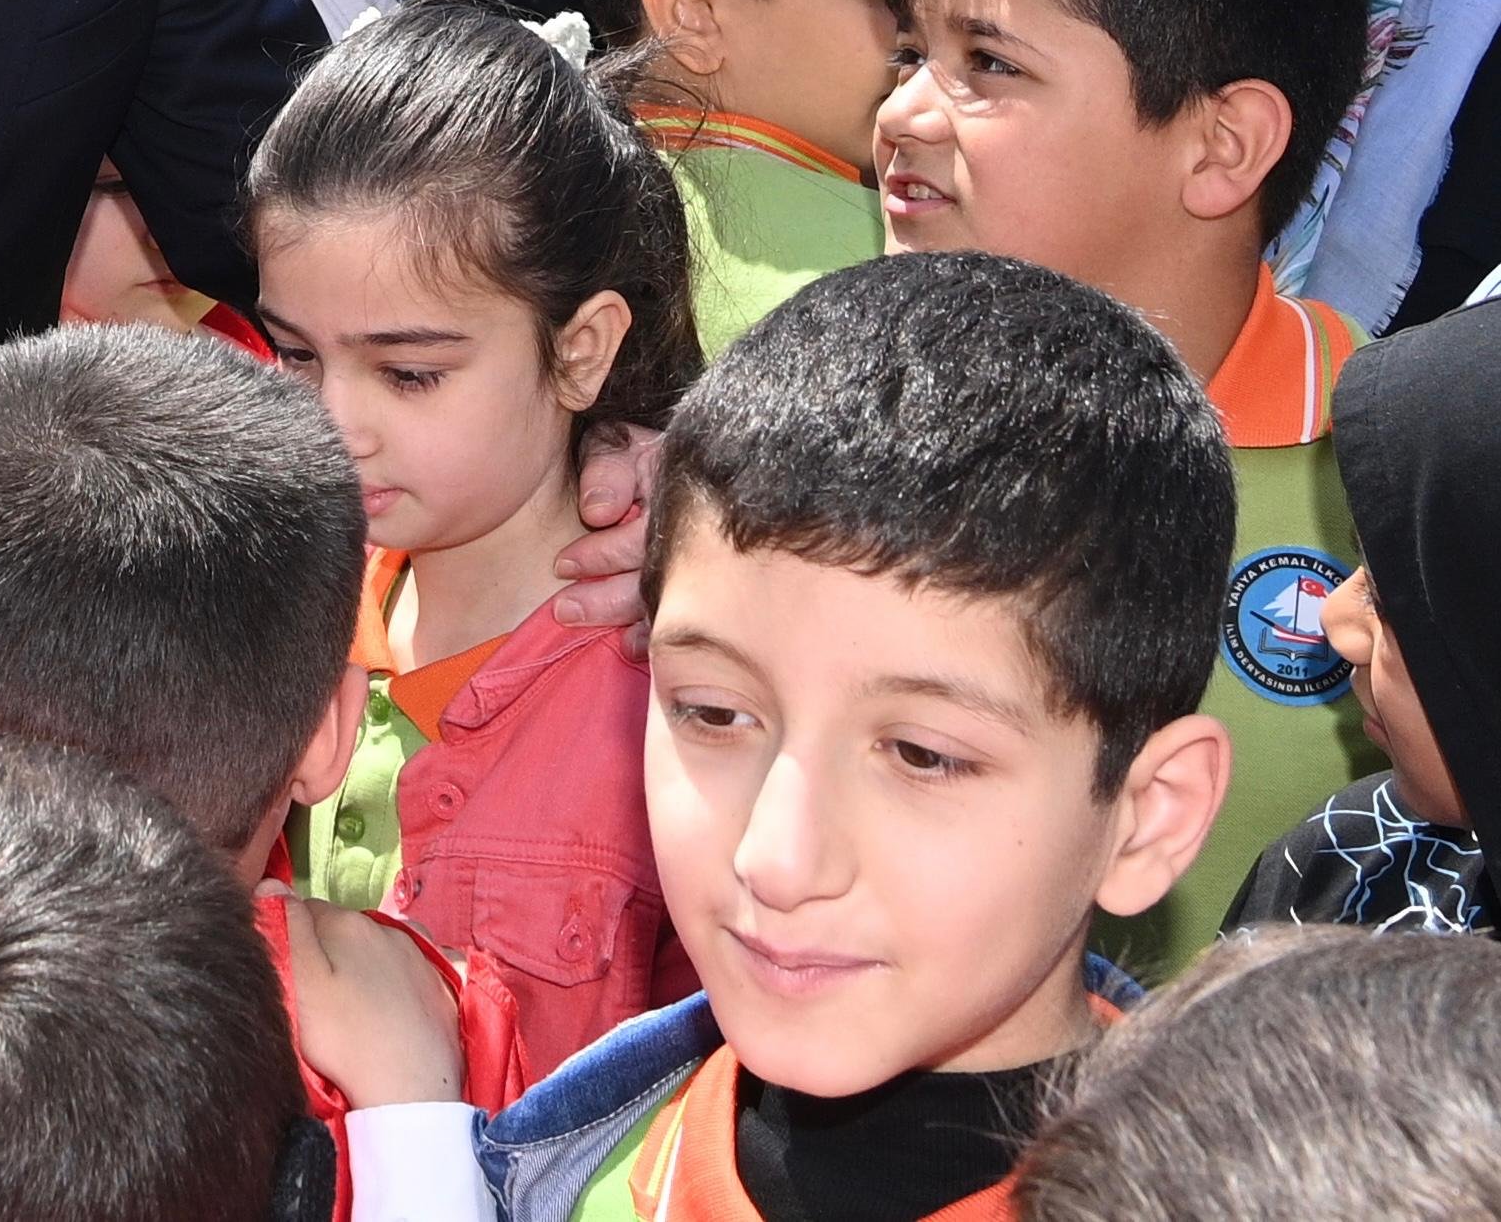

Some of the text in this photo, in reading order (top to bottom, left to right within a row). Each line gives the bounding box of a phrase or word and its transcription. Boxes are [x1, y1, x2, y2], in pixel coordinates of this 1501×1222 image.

[1227, 570, 1258, 608] YAHYA
[1258, 556, 1308, 572] KEMAL
[1277, 663, 1309, 677] 2011
